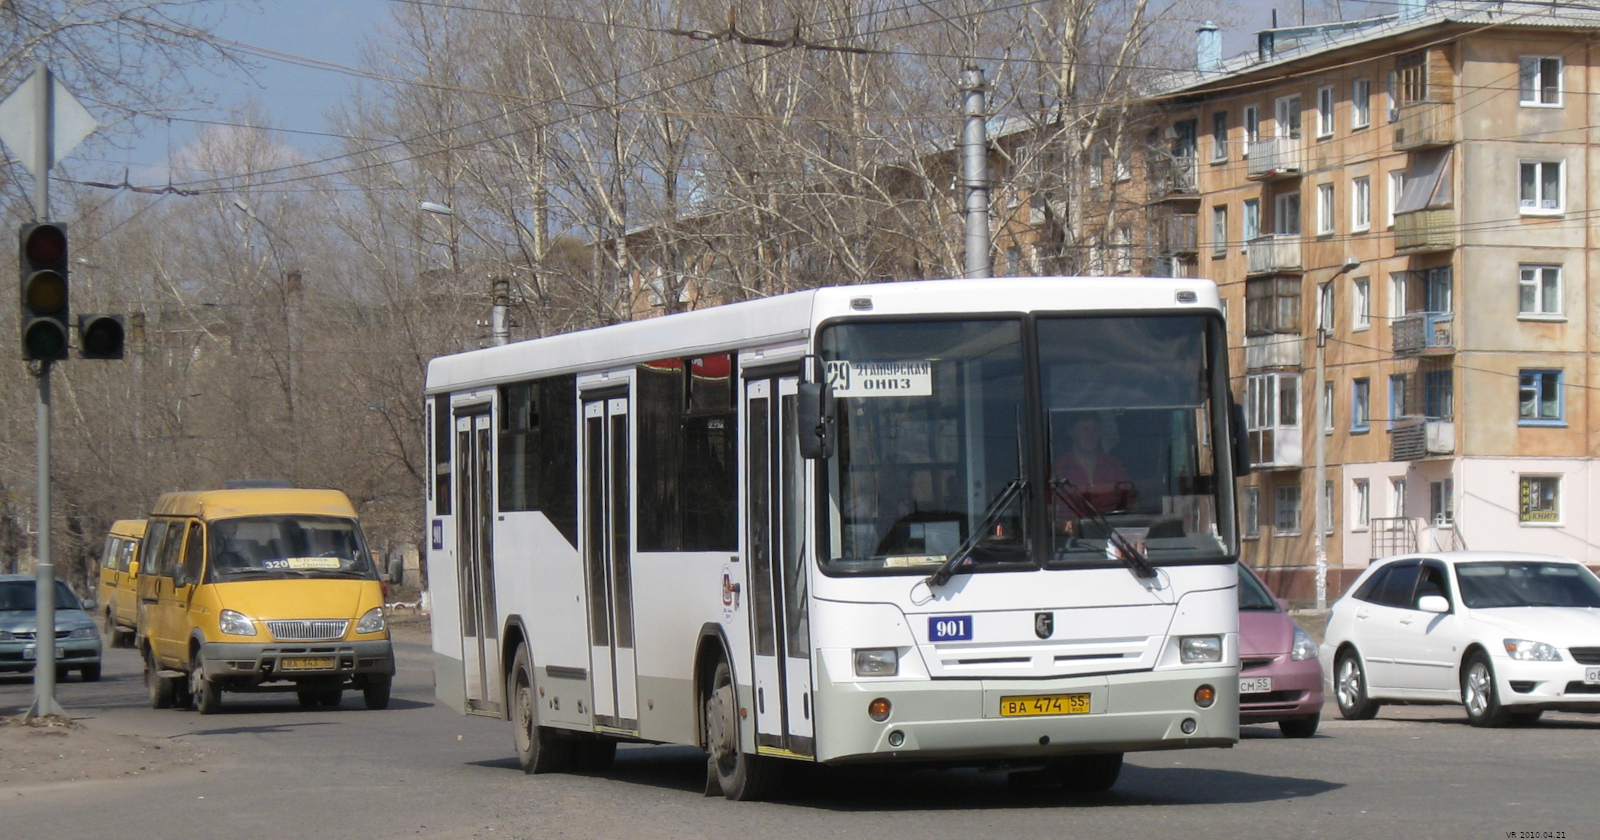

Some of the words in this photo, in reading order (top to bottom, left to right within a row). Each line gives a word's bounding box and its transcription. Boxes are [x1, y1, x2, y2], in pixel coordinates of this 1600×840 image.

[828, 362, 850, 390] 29
[863, 379, 911, 390] ОНПЗ
[1532, 512, 1560, 520] КНИГИ
[265, 560, 288, 569] 320
[936, 620, 965, 637] 901
[1257, 678, 1268, 688] 55
[1034, 697, 1062, 712] 474
[1070, 695, 1085, 706] 55
